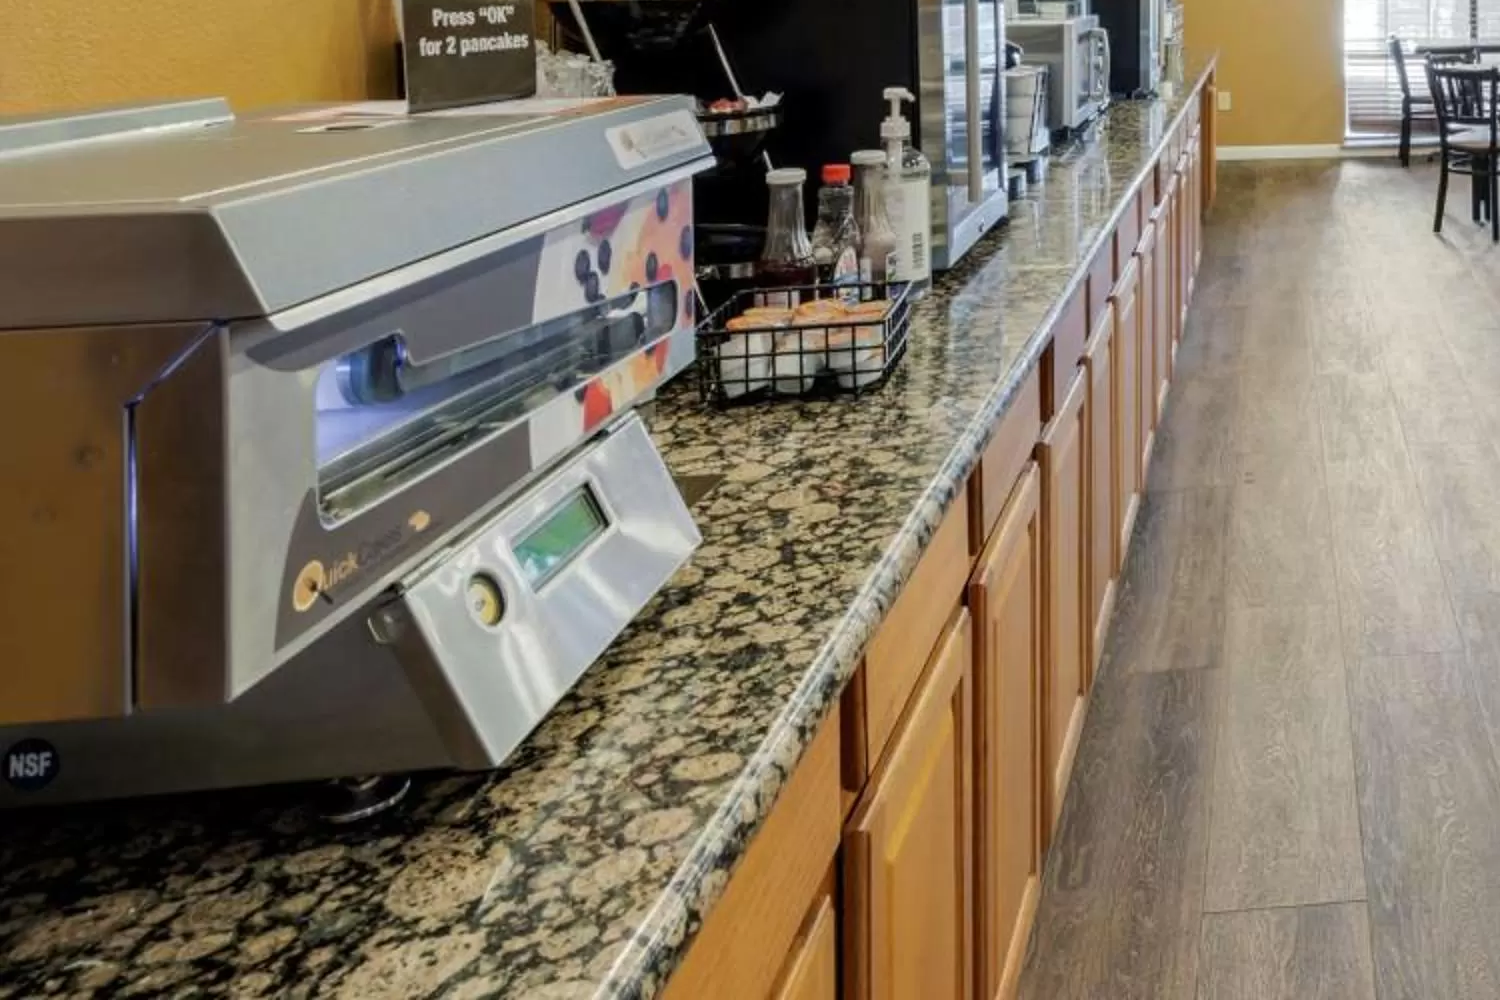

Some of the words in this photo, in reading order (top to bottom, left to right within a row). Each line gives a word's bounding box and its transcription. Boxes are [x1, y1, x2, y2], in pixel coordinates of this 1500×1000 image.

[432, 7, 476, 28] Press
[419, 36, 443, 57] for
[445, 35, 457, 55] 2
[460, 32, 529, 57] pancakes
[8, 751, 53, 779] NSF
